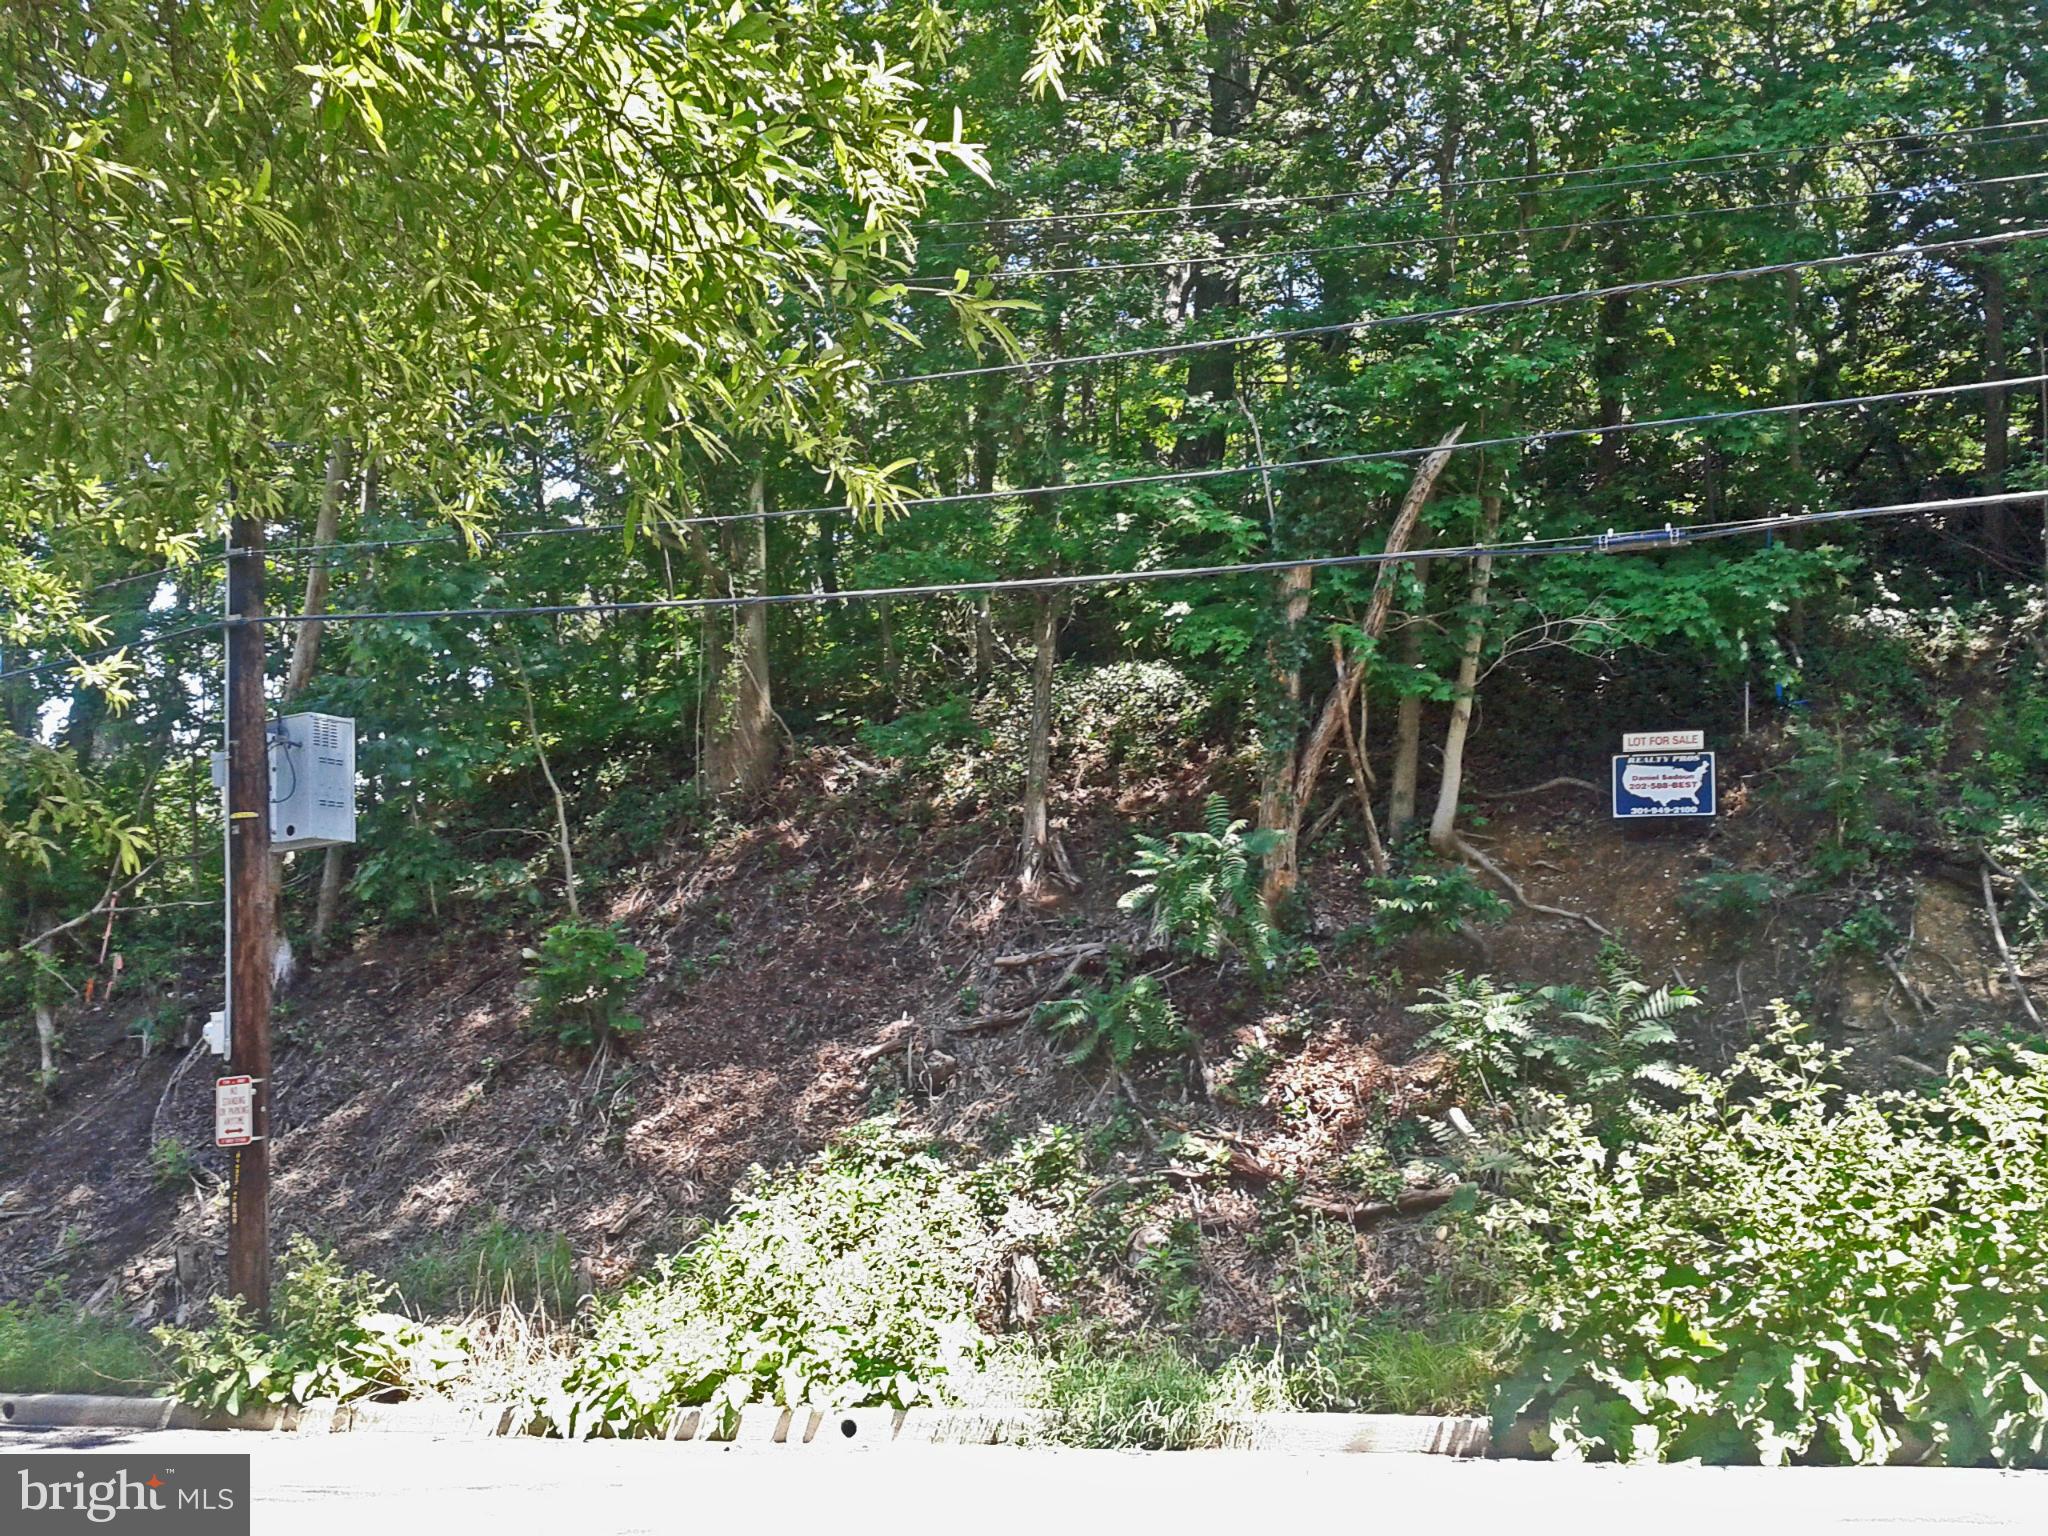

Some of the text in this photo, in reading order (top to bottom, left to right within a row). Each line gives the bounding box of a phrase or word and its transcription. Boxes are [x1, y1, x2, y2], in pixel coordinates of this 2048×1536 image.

[1628, 735, 1699, 747] LOT FOR SALE
[1627, 756, 1669, 764] REALTY
